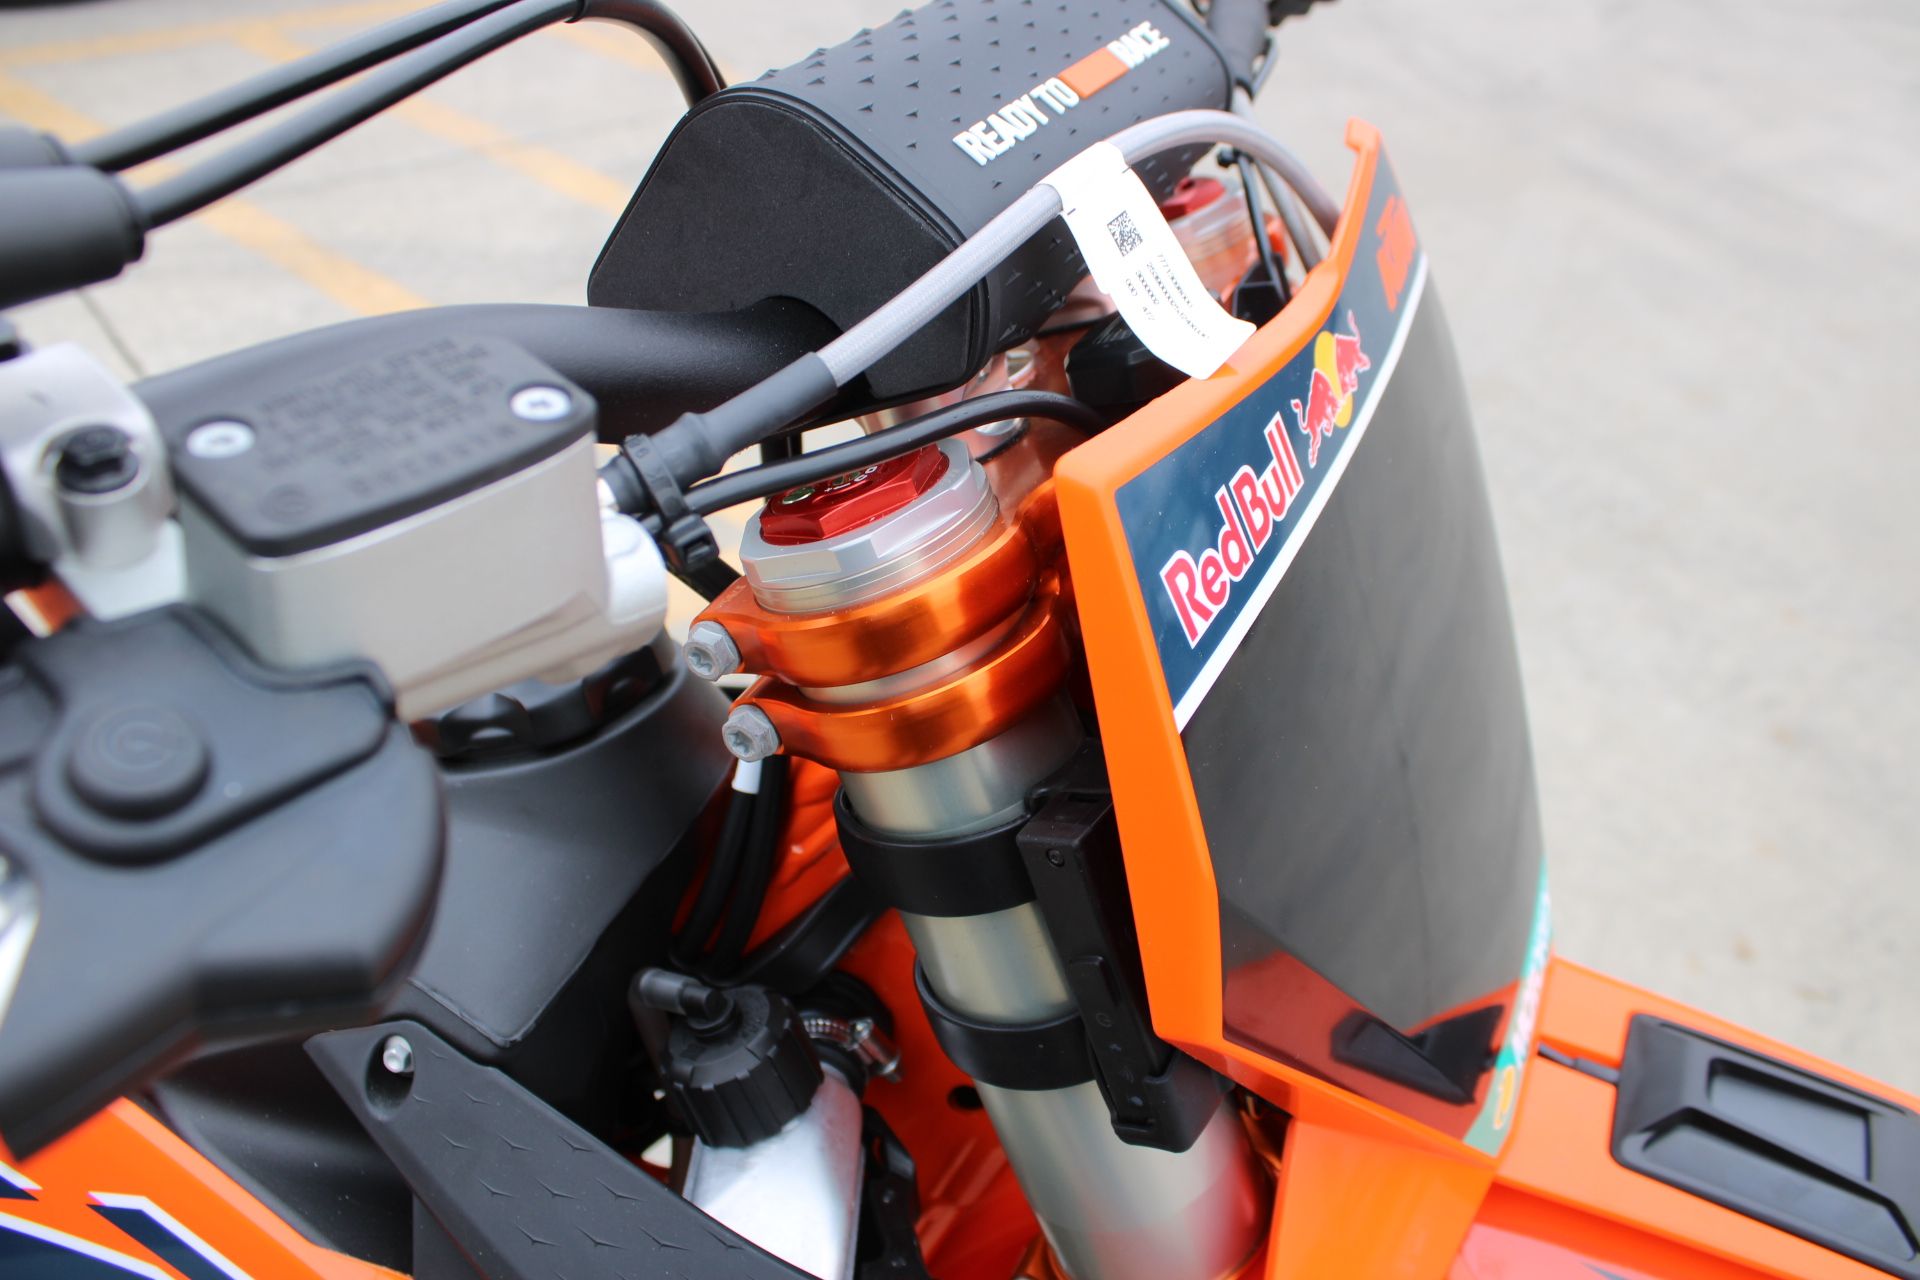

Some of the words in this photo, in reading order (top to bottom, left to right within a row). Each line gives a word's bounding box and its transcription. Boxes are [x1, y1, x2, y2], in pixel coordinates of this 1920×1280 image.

[952, 93, 1049, 167] READY
[1029, 77, 1080, 116] TO
[1106, 20, 1170, 69] RACE
[1160, 485, 1255, 649] Red
[1229, 411, 1304, 554] Bull
